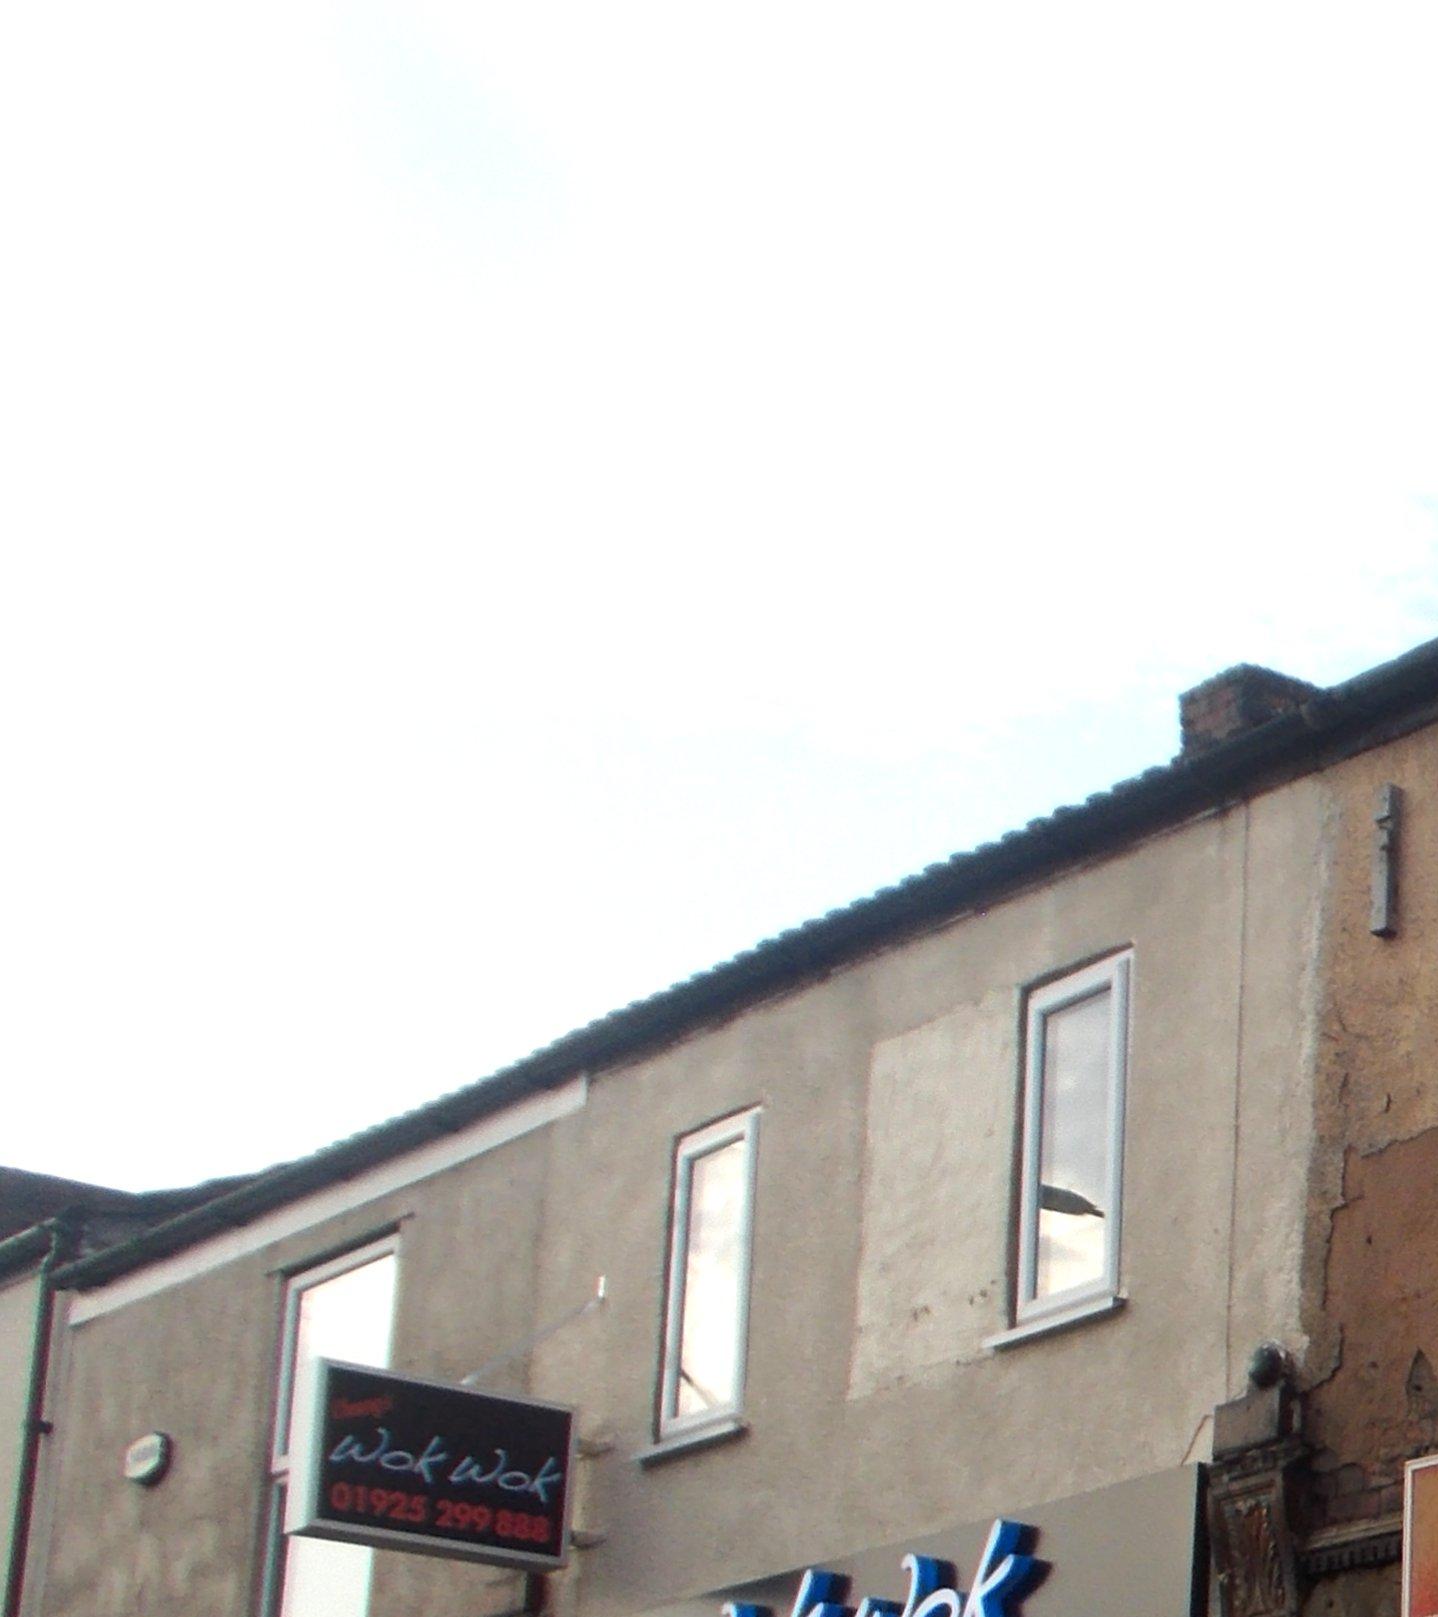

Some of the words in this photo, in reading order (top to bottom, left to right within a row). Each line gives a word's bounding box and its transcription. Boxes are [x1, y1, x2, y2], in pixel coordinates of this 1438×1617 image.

[330, 1481, 428, 1524] 01925
[436, 1499, 492, 1533] 299
[495, 1509, 550, 1544] 888
